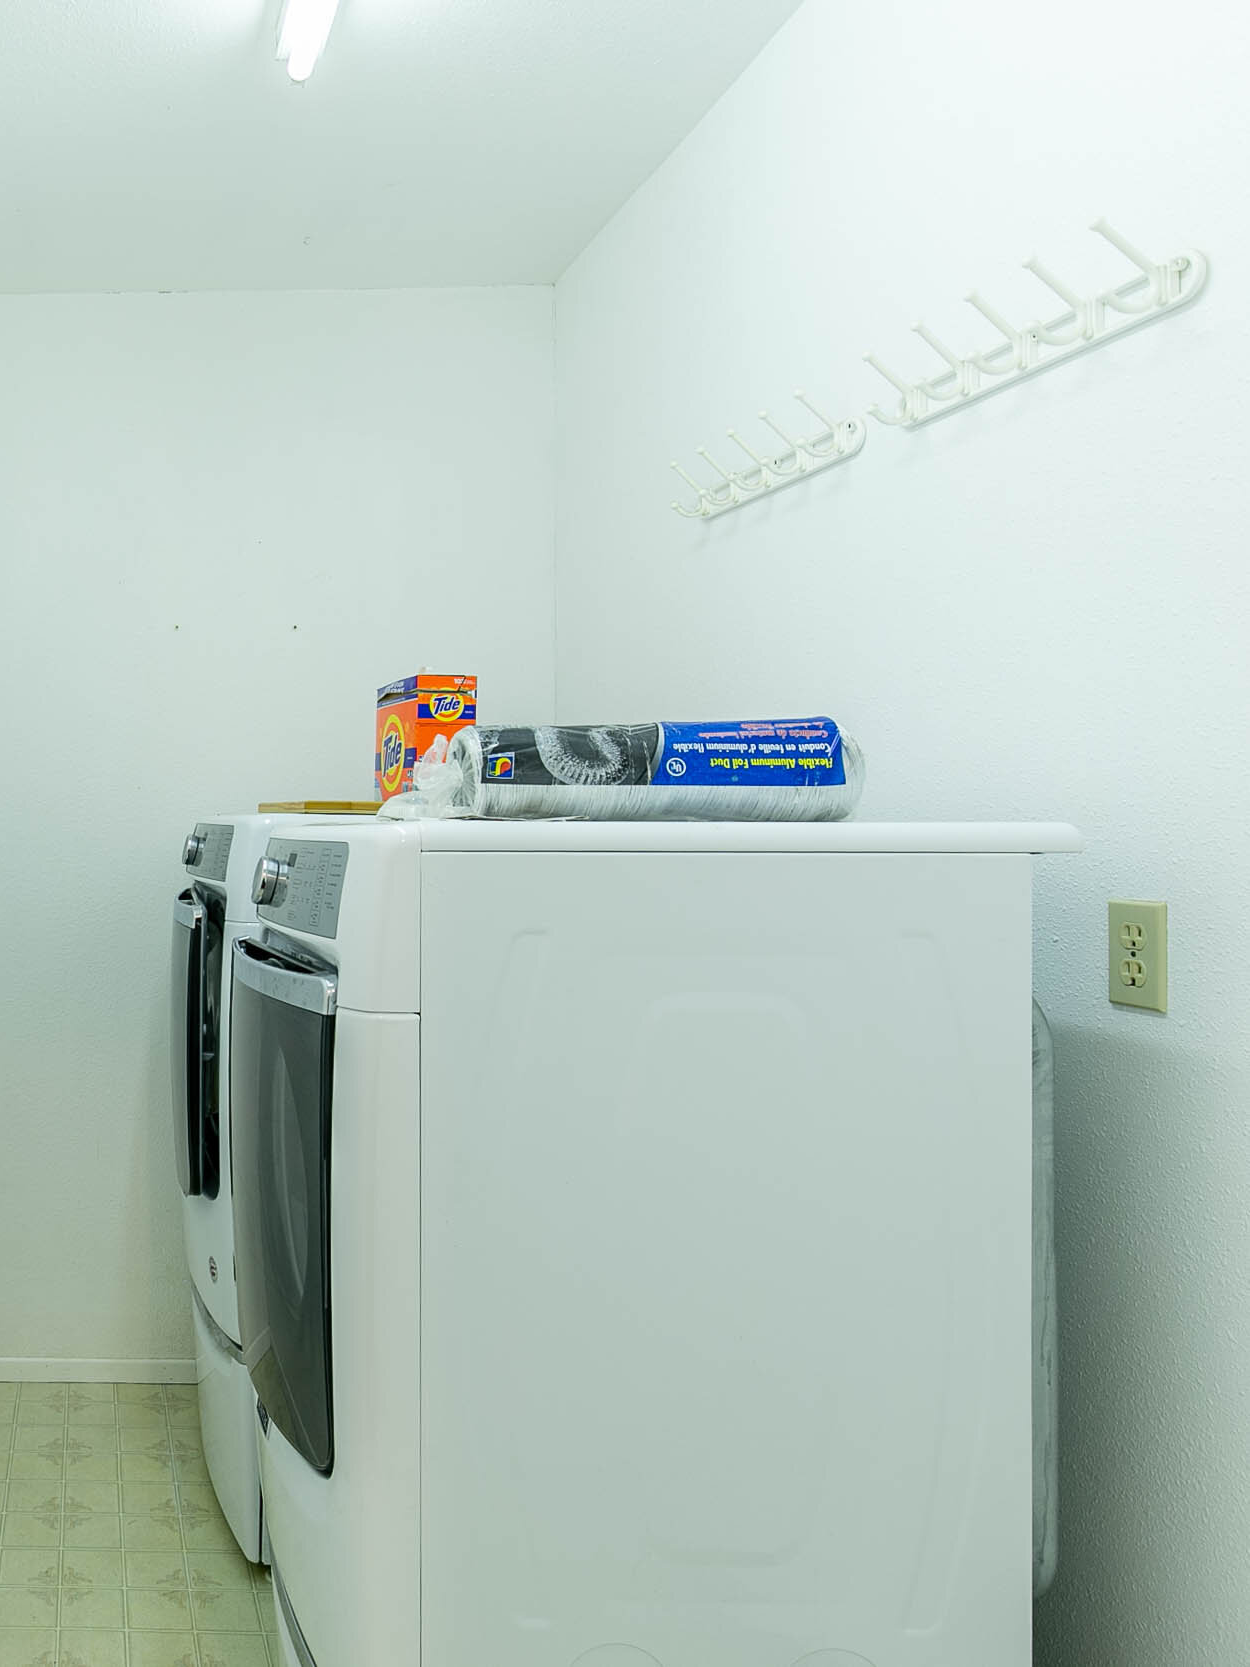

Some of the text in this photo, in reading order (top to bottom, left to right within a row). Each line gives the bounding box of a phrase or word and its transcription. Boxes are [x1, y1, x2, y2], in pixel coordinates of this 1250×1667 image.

[433, 695, 461, 715] Tide
[673, 743, 705, 753] flexible
[758, 743, 785, 754] feuille
[785, 743, 797, 751] en
[798, 743, 831, 754] Conduit
[383, 733, 402, 777] Tide
[710, 758, 833, 769] Flexible Aluminum Foil Duct
